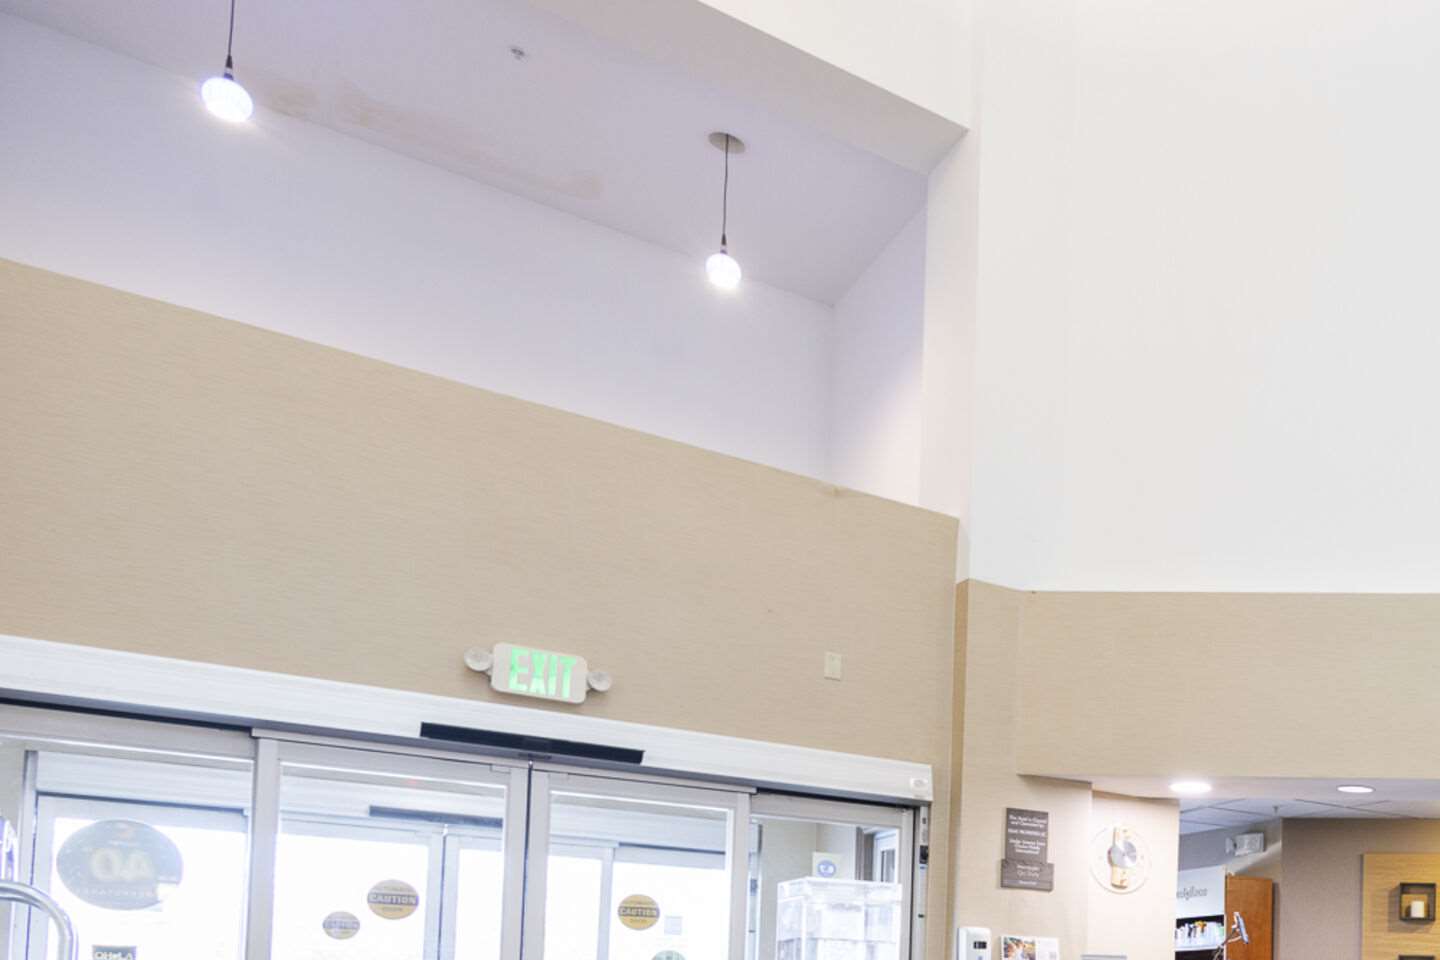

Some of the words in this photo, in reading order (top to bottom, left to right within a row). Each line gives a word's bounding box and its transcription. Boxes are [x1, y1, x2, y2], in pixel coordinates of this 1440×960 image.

[508, 647, 577, 698] EXIT
[369, 893, 417, 905] CAUTION
[620, 906, 657, 917] CAUTION
